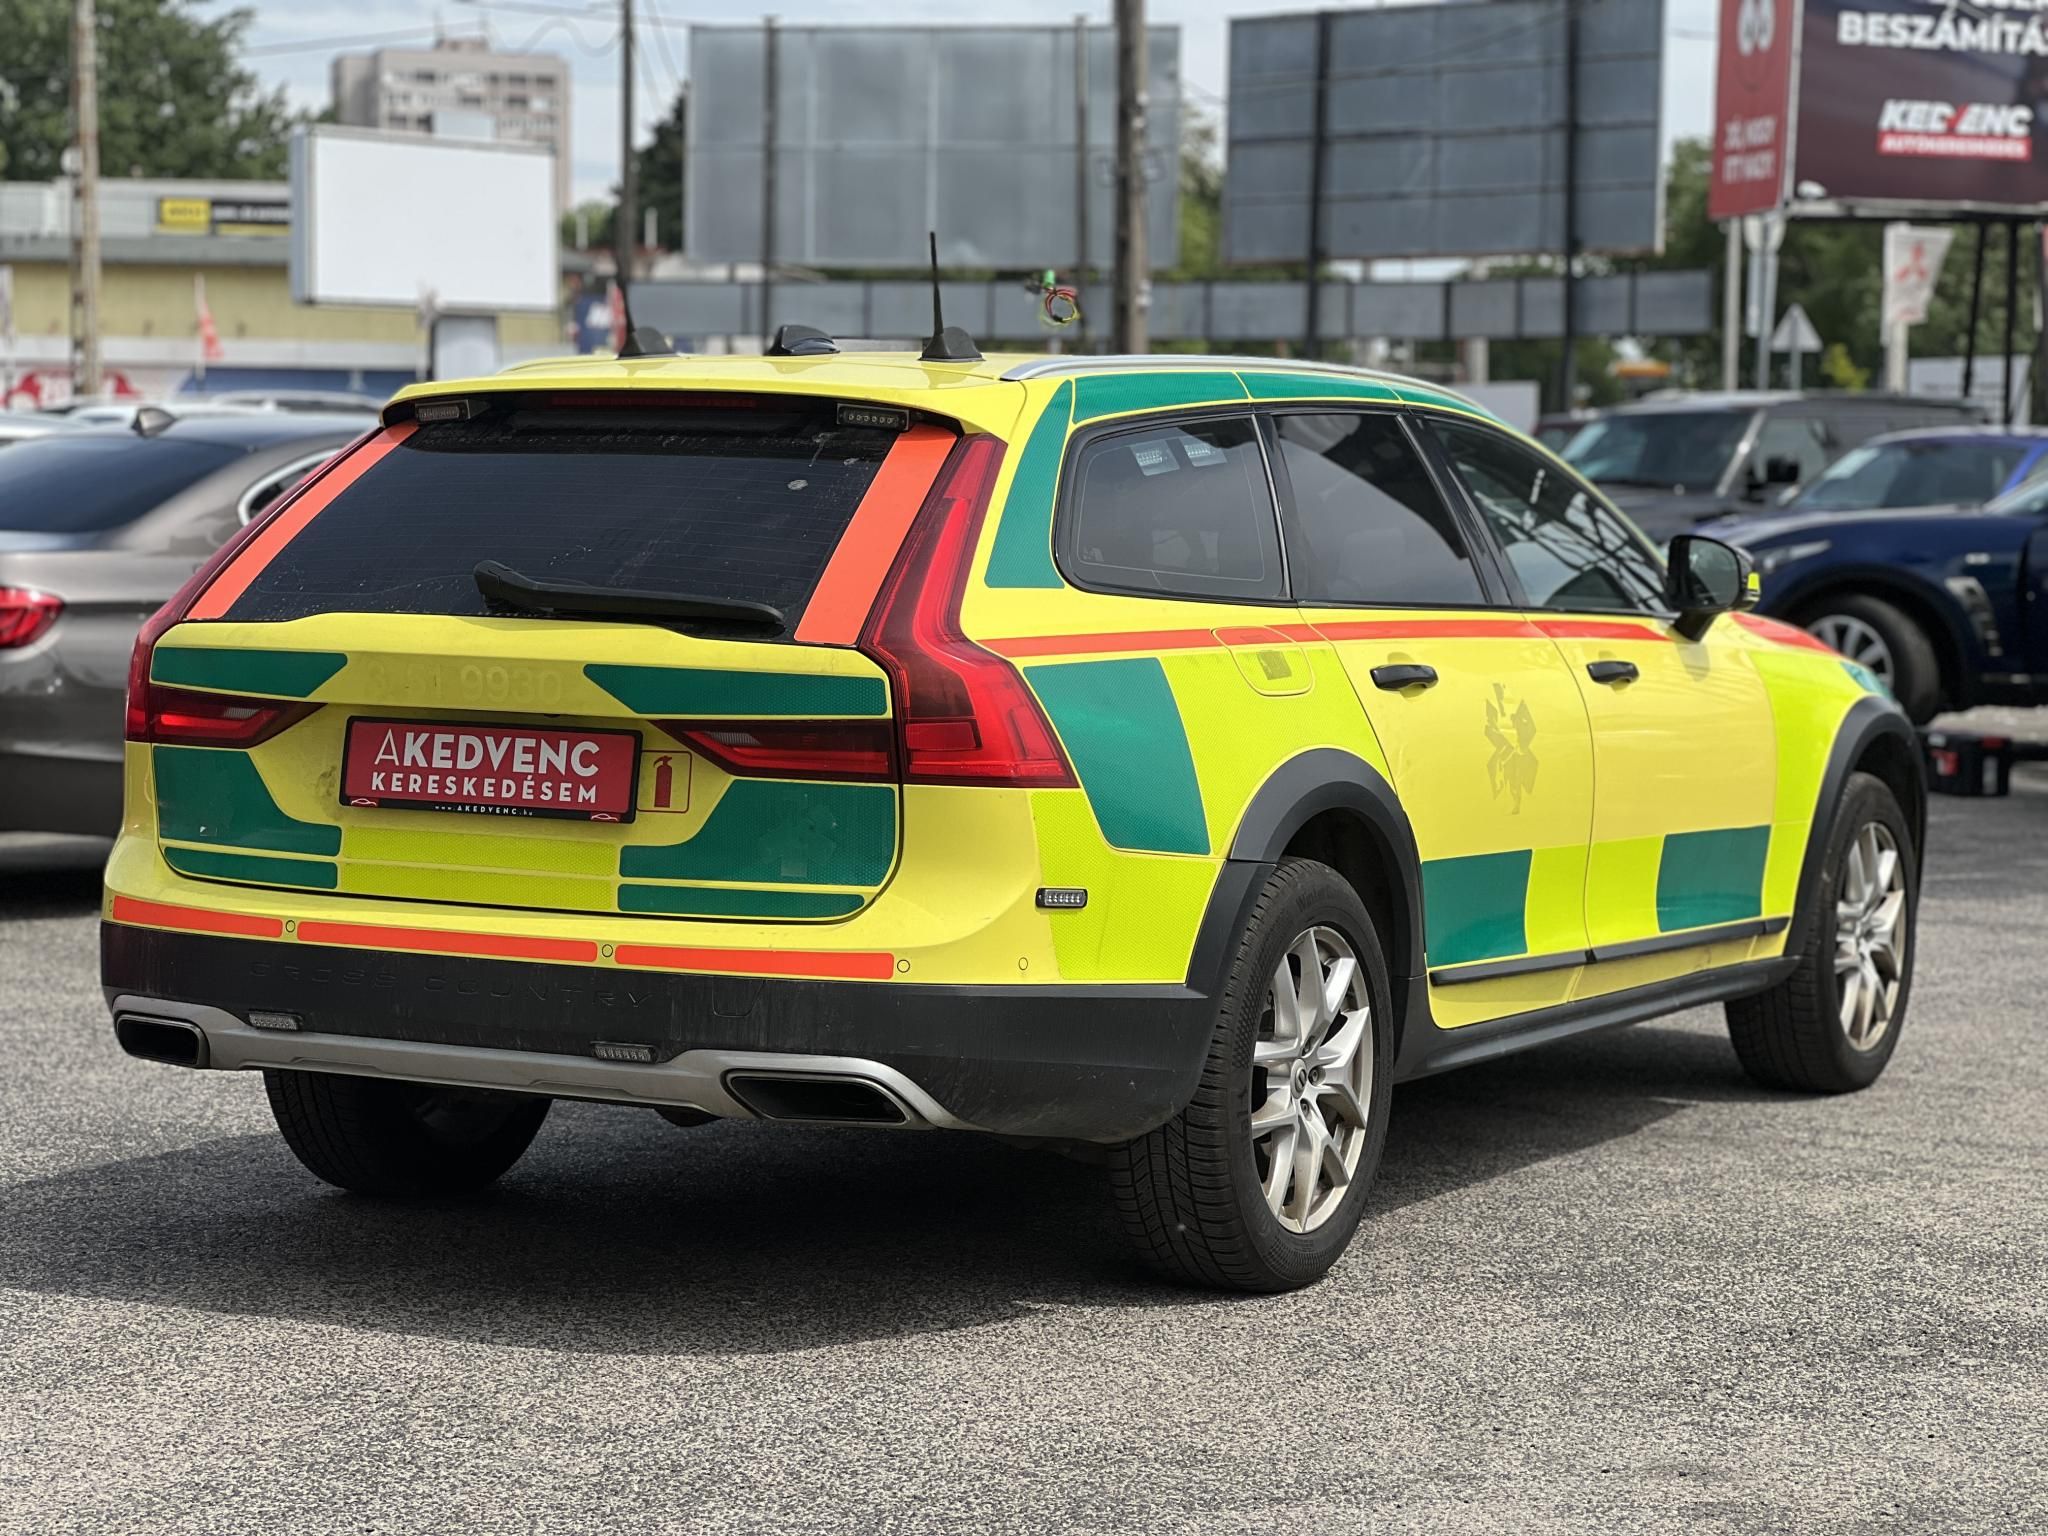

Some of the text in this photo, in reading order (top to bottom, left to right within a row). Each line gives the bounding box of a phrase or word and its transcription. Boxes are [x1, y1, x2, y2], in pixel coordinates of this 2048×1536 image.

[1838, 4, 2048, 56] BESZÁMÍTÁ
[374, 728, 600, 777] AKEDVENC
[371, 772, 597, 804] KERESKEDÉSEM
[248, 960, 655, 1008] CROSS COUNTRY
